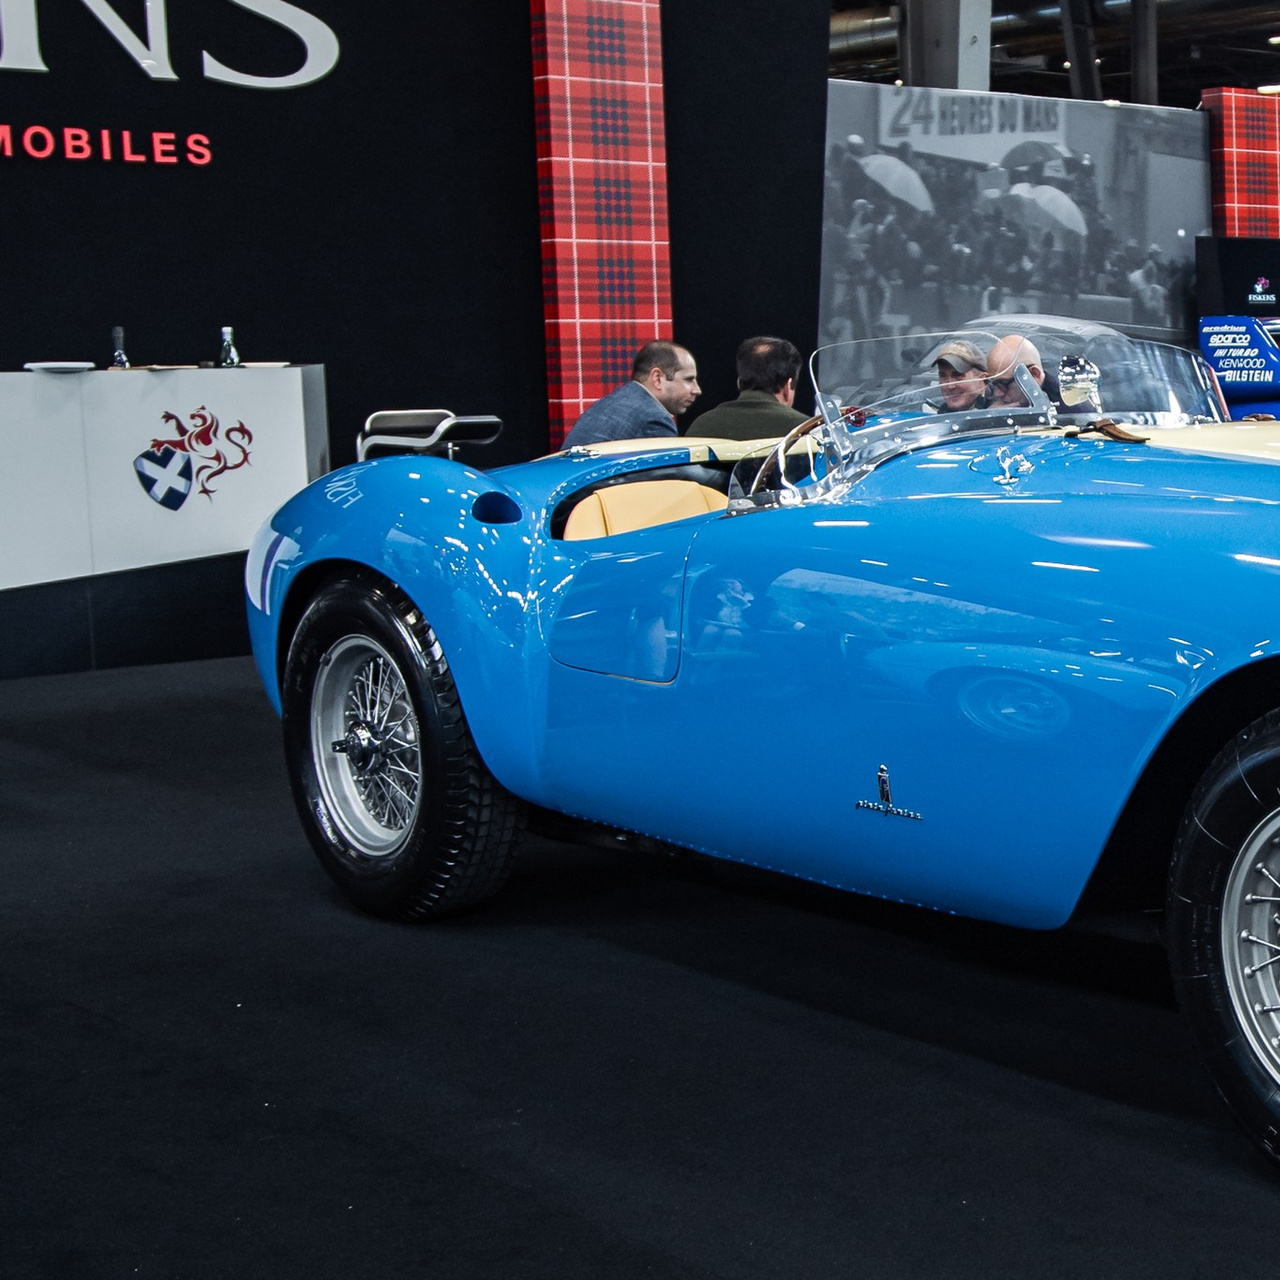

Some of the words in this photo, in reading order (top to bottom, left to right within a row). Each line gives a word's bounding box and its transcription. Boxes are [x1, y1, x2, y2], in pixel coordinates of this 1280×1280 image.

[888, 87, 934, 137] 24
[1248, 294, 1276, 302] FISKENS
[1209, 334, 1251, 345] sparco
[1213, 348, 1228, 357] IHI
[1227, 348, 1259, 357] TURBO
[1218, 358, 1266, 369] KENWOOD
[1225, 370, 1274, 382] BILSTEIN
